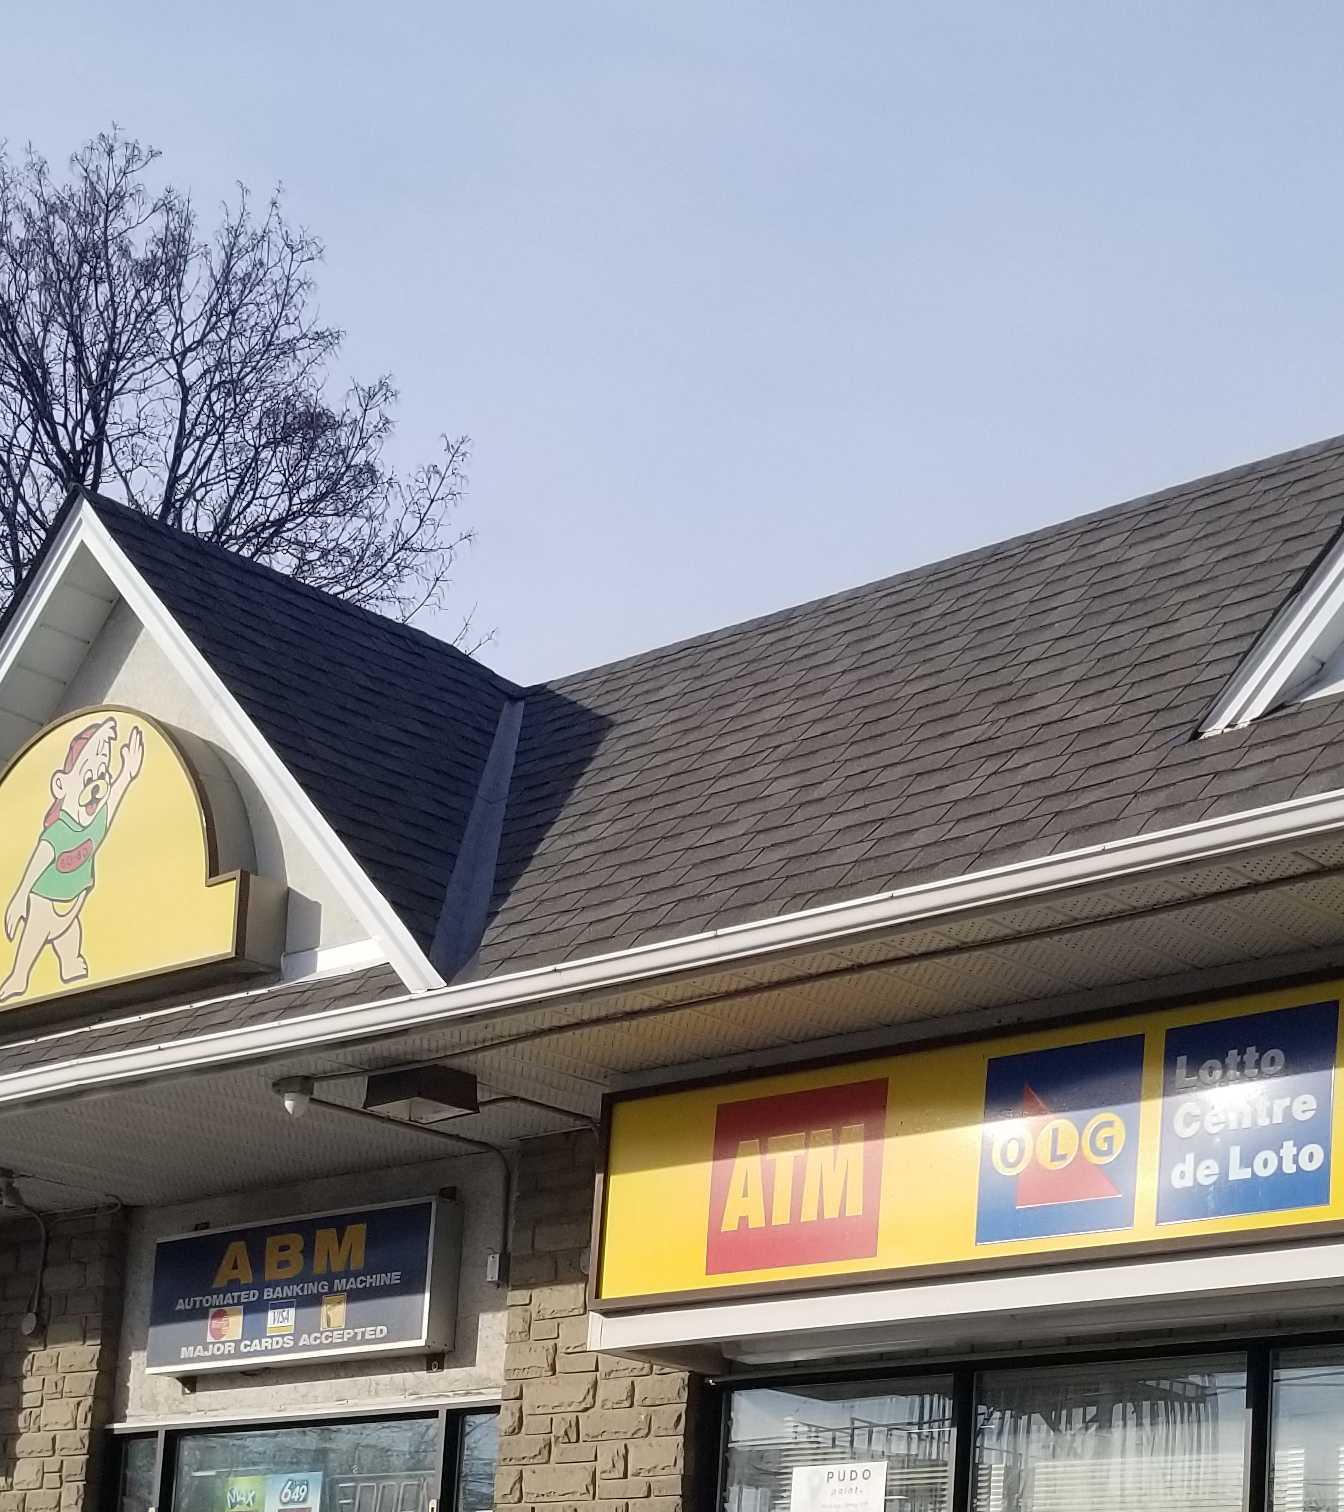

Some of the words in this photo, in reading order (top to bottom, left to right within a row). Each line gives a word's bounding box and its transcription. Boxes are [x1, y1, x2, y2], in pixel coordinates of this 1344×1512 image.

[1174, 1045, 1286, 1090] Lotto
[1172, 1092, 1318, 1139] Centre
[997, 1115, 1121, 1172] OLG
[1170, 1153, 1220, 1189] de
[1228, 1140, 1325, 1182] Loto
[720, 1123, 865, 1232] ATM
[212, 1223, 367, 1288] ABM
[175, 1290, 259, 1311] AUTOMATED
[263, 1281, 329, 1299] BANKING
[333, 1271, 402, 1293] MACHINE
[180, 1341, 236, 1359] MAJOR
[240, 1335, 295, 1353] CARDS
[298, 1325, 388, 1346] ACCEPTED
[826, 1468, 872, 1483] PUDO
